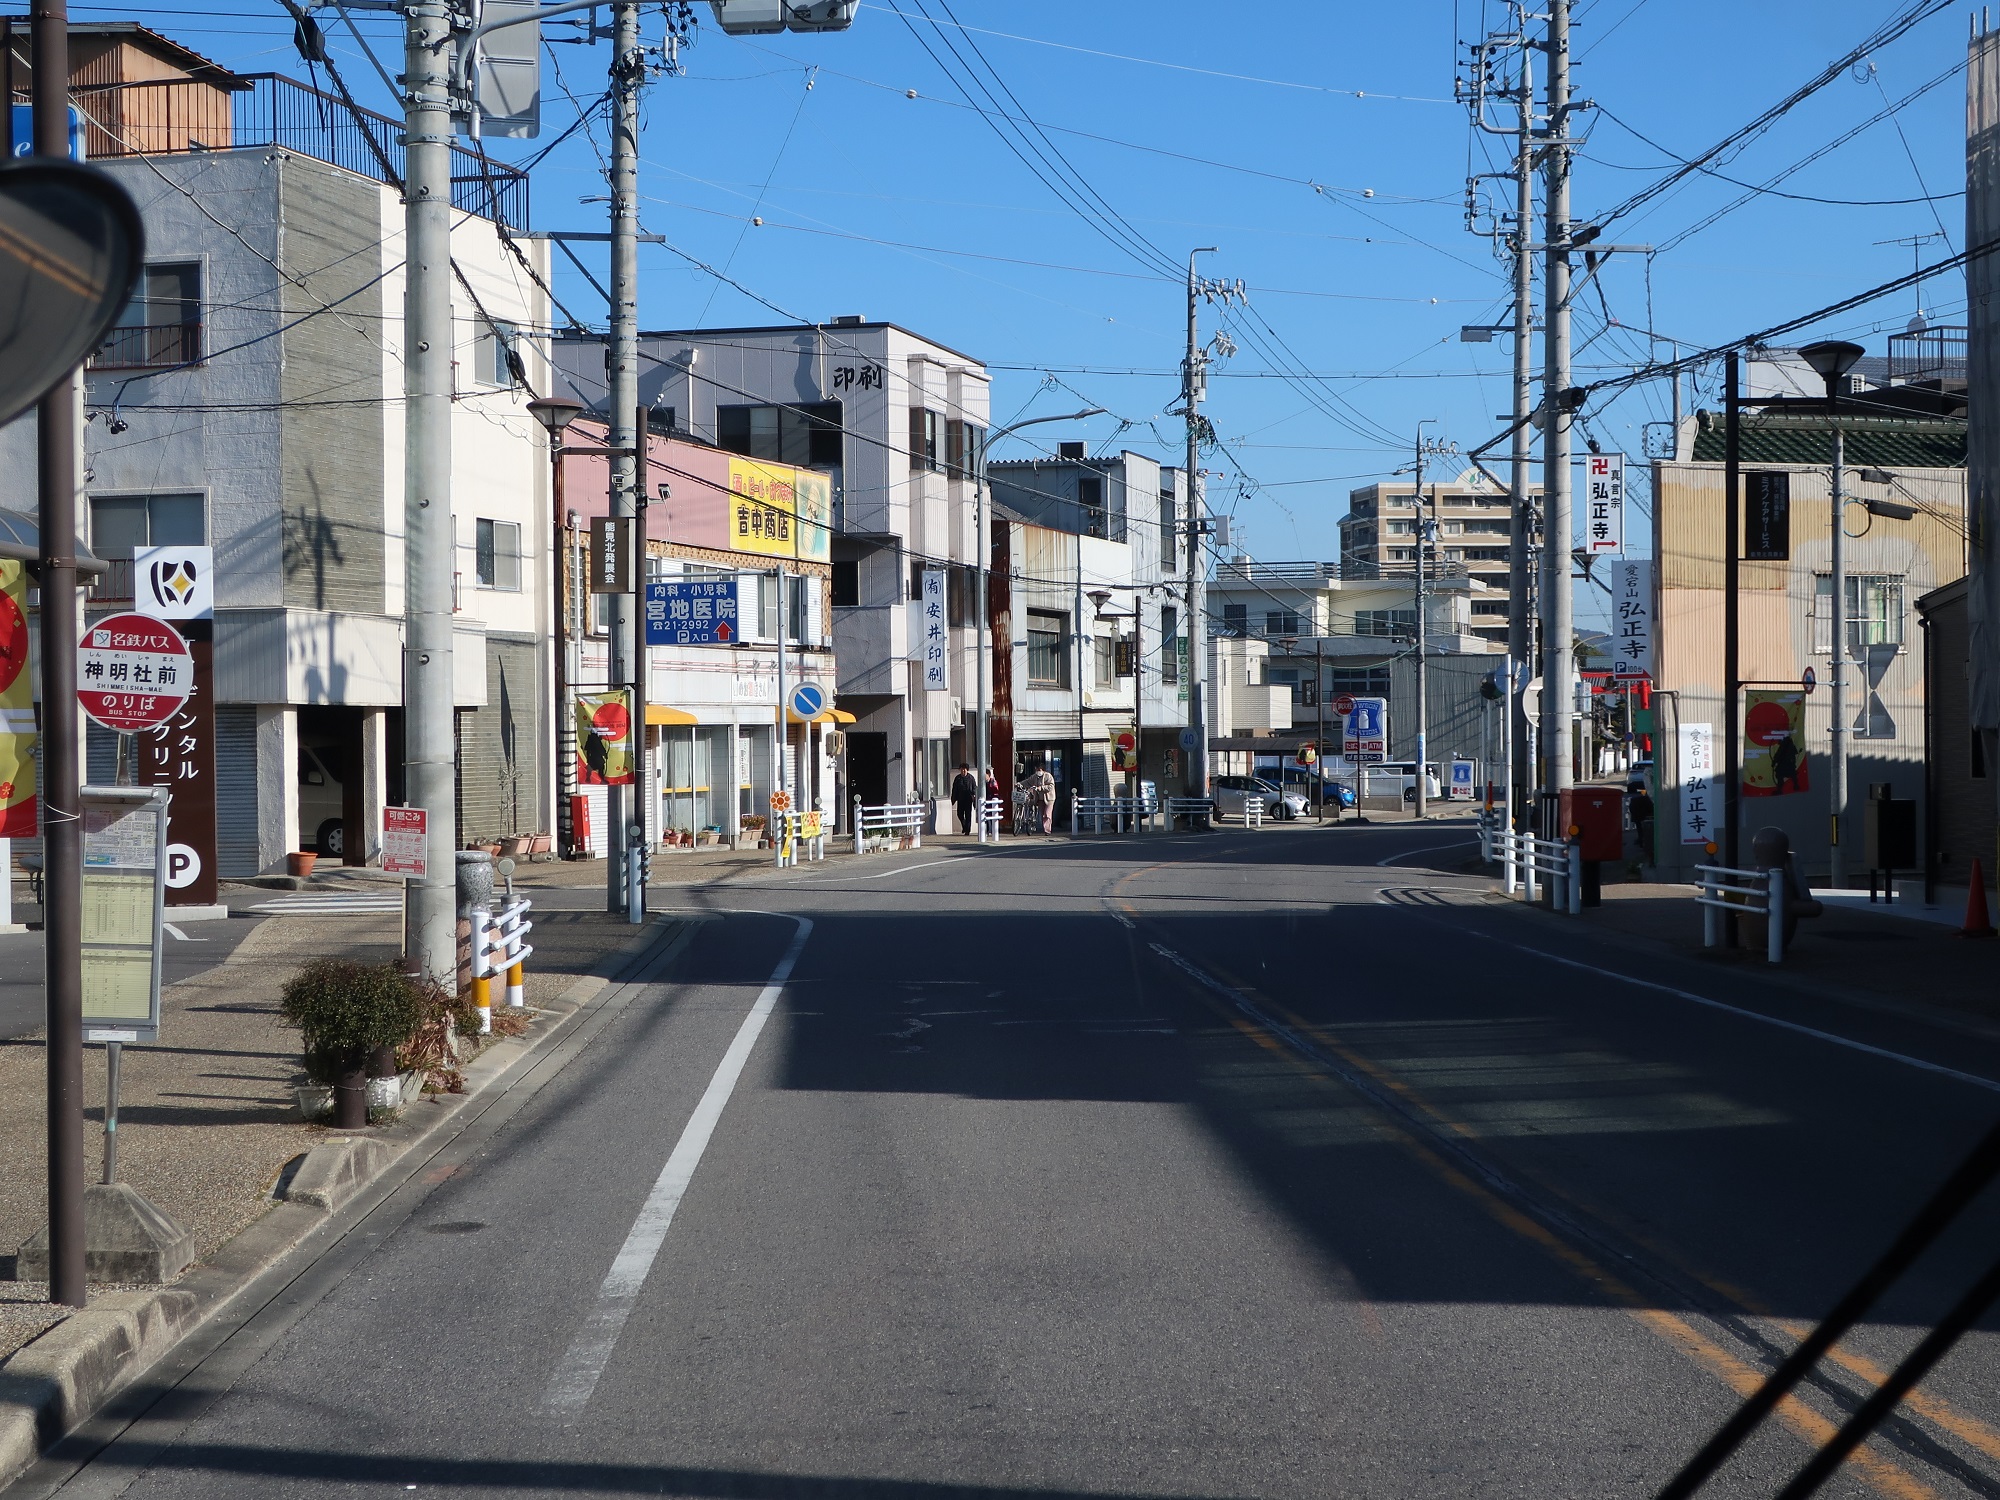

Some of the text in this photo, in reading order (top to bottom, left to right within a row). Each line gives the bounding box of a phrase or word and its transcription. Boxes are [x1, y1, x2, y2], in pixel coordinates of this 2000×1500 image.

[832, 364, 882, 392] 印刷
[1610, 469, 1621, 509] 真言宗
[737, 503, 789, 541] 吉中商店
[1592, 482, 1609, 540] 弘正寺
[604, 521, 616, 584] 能見北発展会
[654, 583, 728, 597] 内科・小児科
[646, 597, 736, 621] 宮地医院
[1619, 564, 1647, 659] 愛宕山 弘正寺
[112, 633, 169, 648] 名鉄バス
[692, 633, 709, 642] 入口
[85, 661, 176, 685] 神明社前
[96, 683, 162, 692] SHIMMEISHA-MAE
[102, 694, 156, 710] のりば
[1184, 733, 1194, 744] 40
[1368, 742, 1382, 750] ATM
[389, 811, 421, 821] 可燃ごみ
[1687, 776, 1707, 833] 弘正寺
